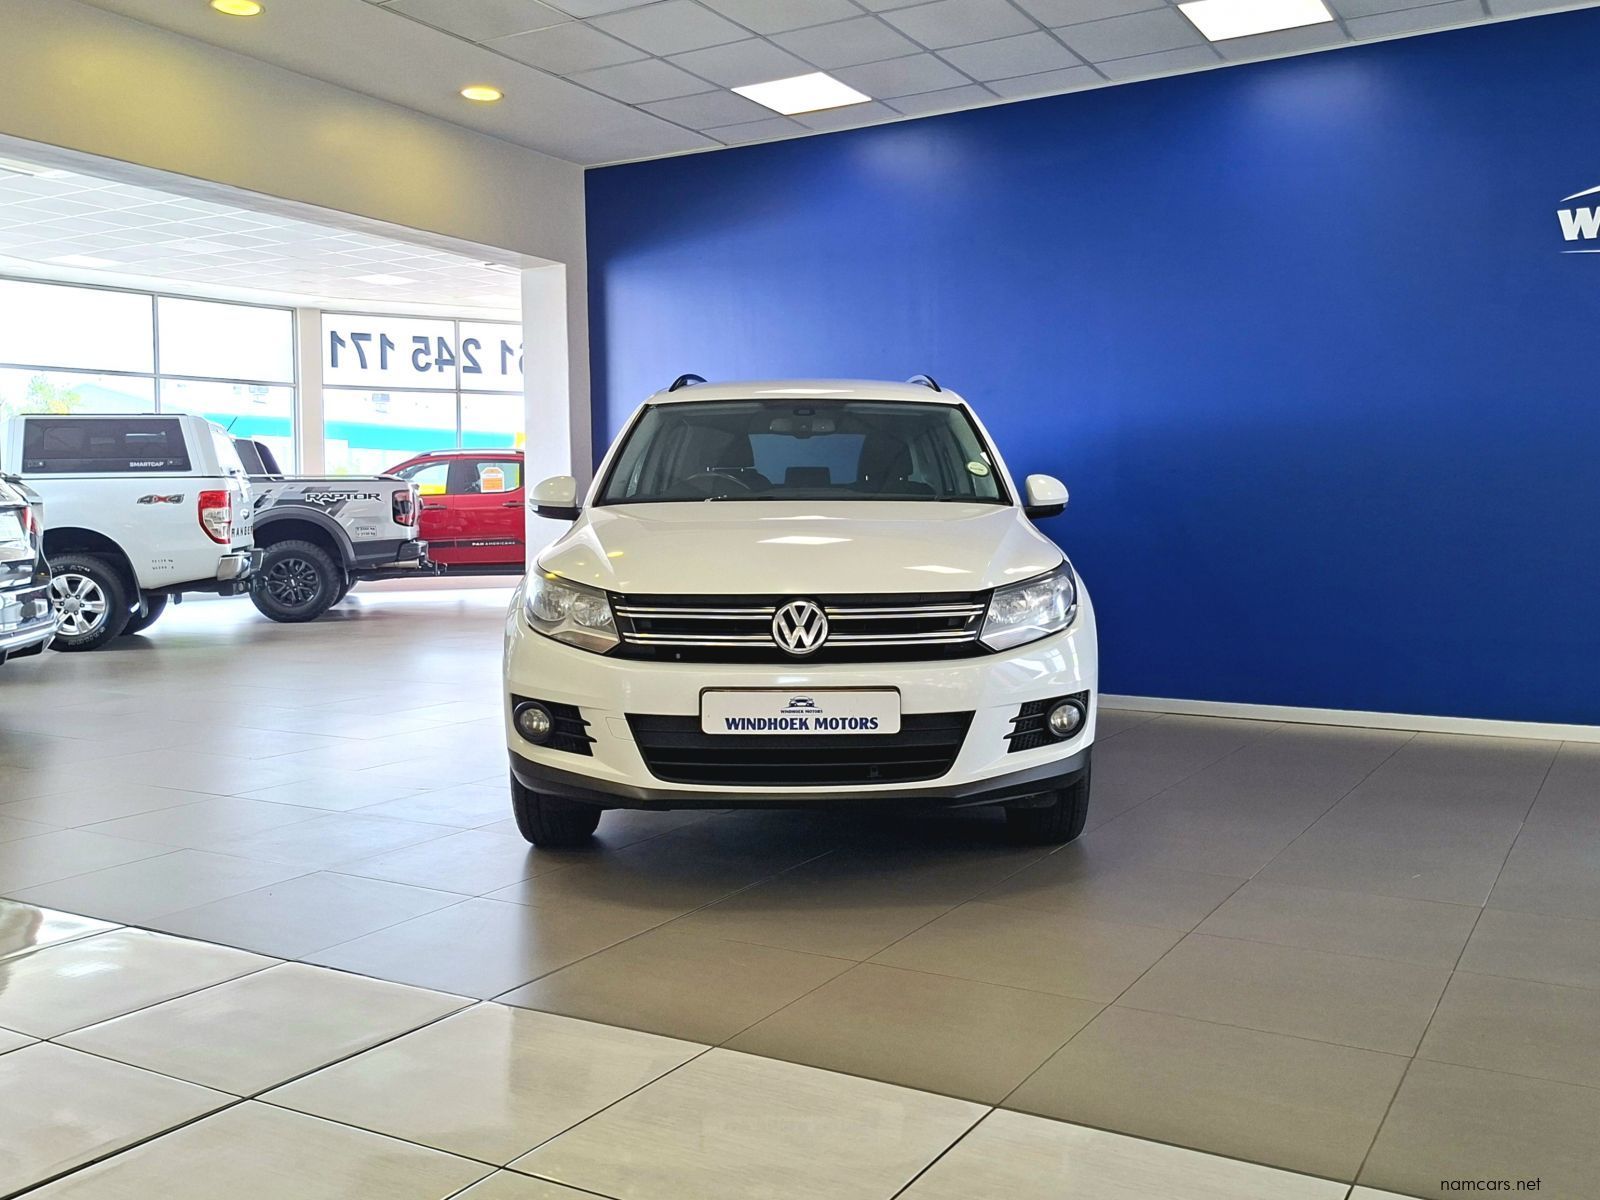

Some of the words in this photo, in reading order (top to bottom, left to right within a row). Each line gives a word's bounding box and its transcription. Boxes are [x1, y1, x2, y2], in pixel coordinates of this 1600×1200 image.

[305, 492, 382, 506] RAPTOR
[725, 717, 810, 731] WINDHOEK
[814, 717, 879, 730] MOTORS
